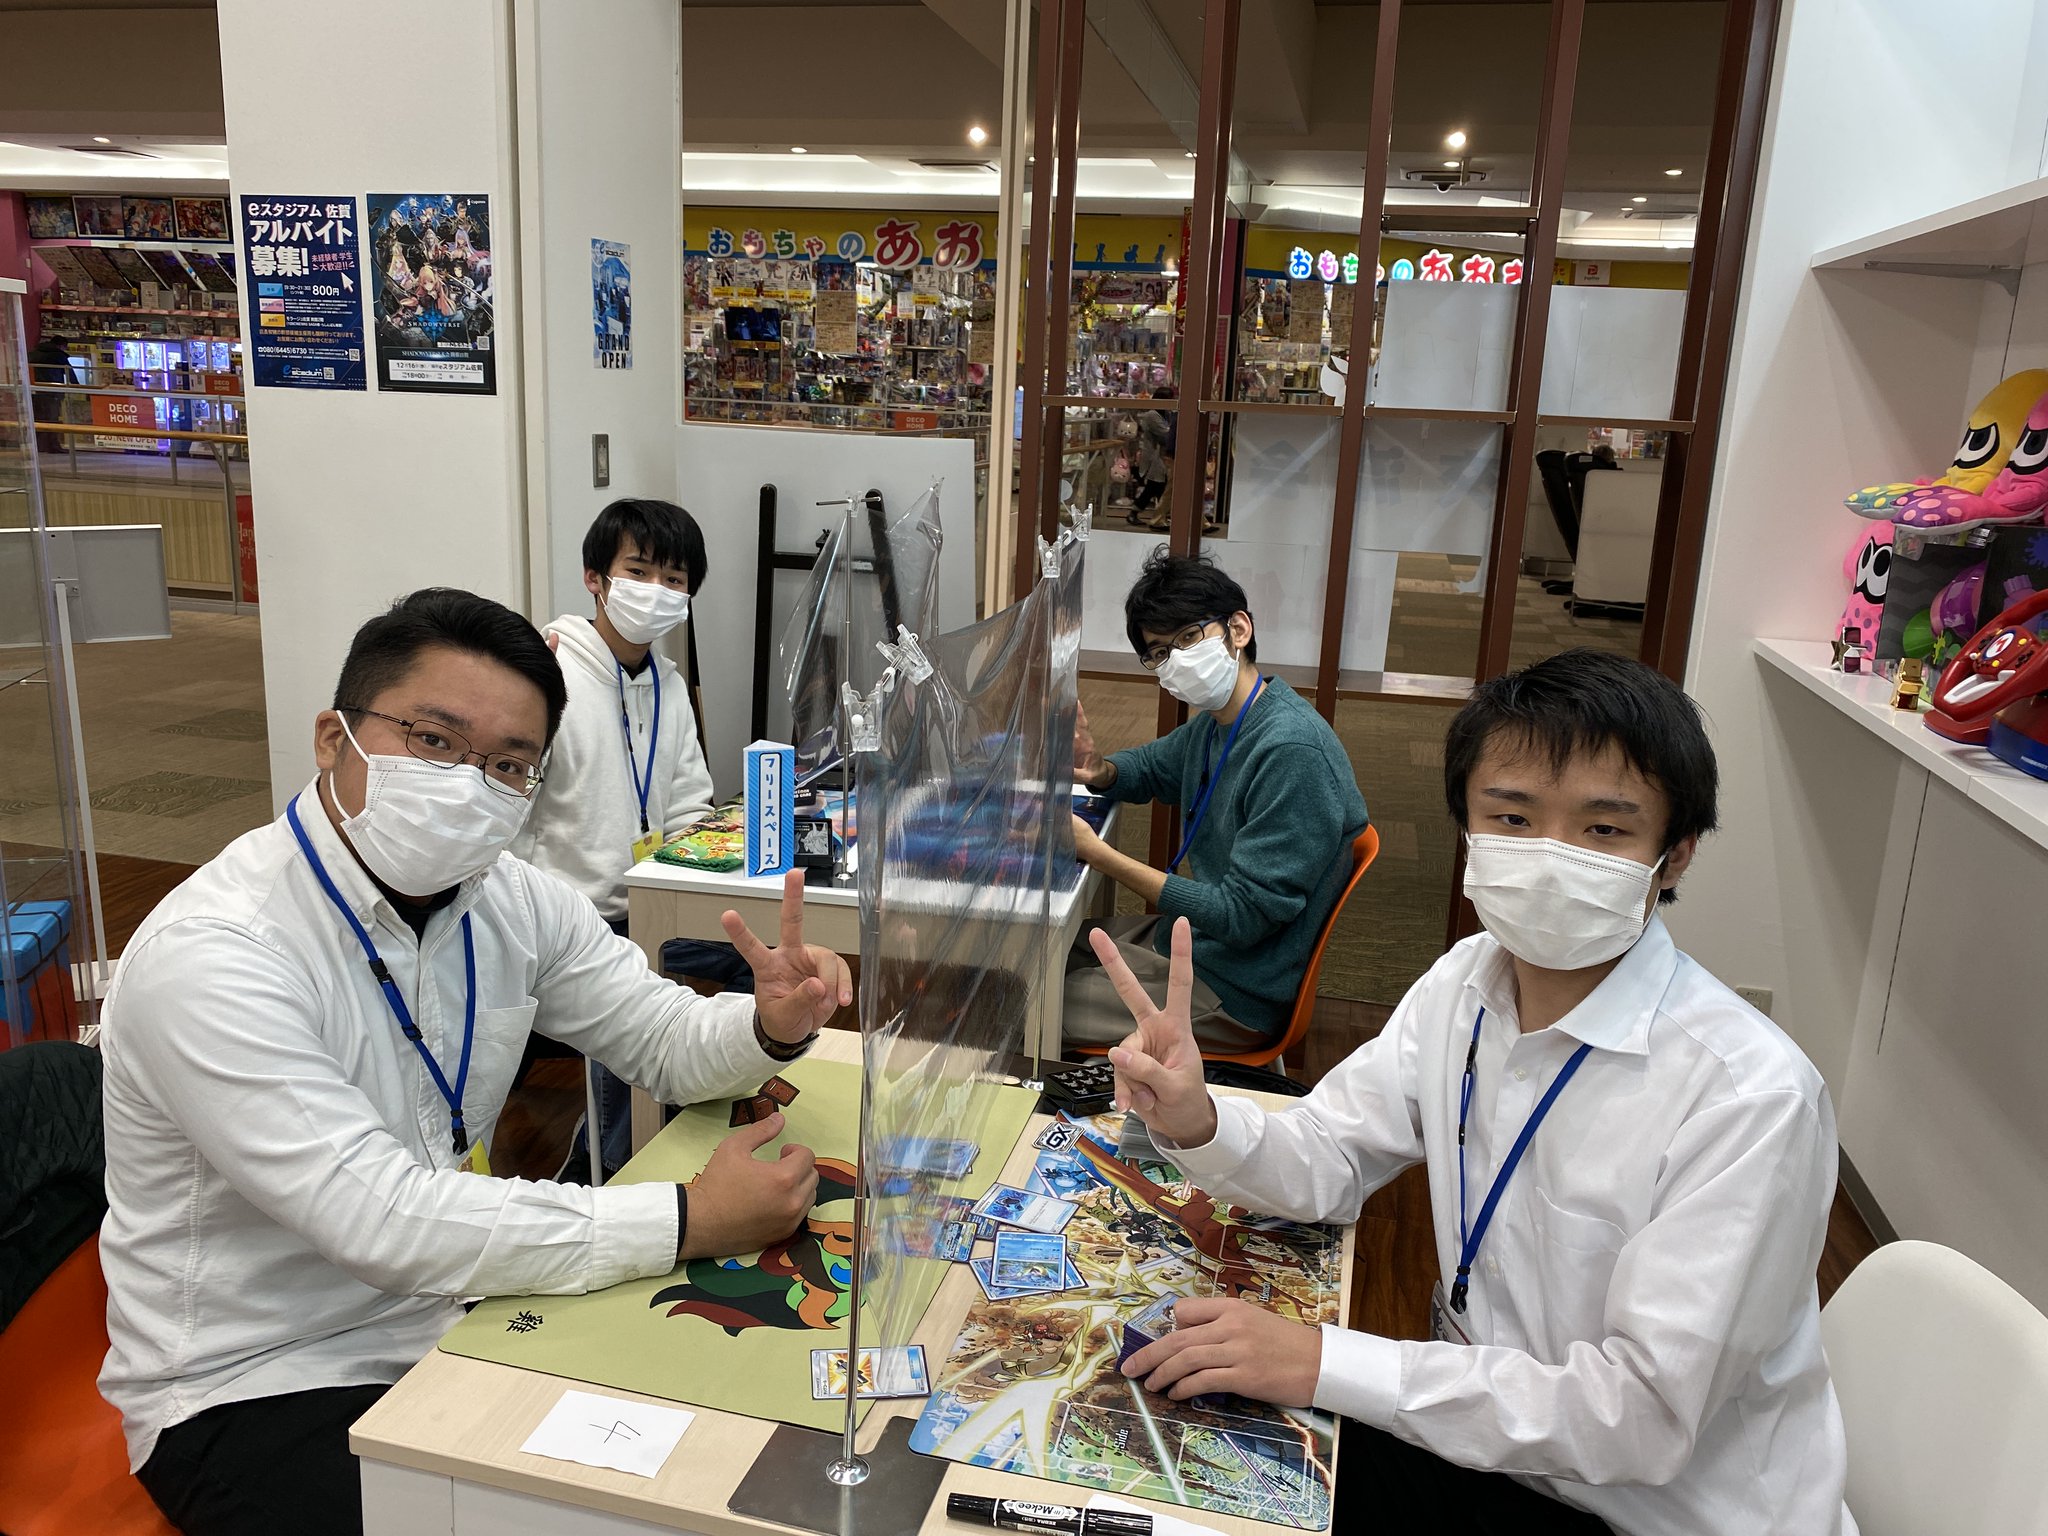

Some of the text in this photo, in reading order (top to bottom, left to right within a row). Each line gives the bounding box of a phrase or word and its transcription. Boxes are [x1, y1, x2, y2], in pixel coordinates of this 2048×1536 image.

[248, 202, 351, 219] eスタジアム 佐賀
[249, 219, 353, 245] アルバイト
[250, 245, 309, 277] 募集!
[312, 285, 340, 297] 800円
[598, 333, 630, 351] GRAND
[602, 352, 627, 368] OPEN
[108, 403, 138, 414] DECO
[110, 414, 138, 424] HOME
[764, 758, 777, 865] フリースペース
[1046, 1125, 1072, 1149] GX
[1115, 1428, 1129, 1451] Side
